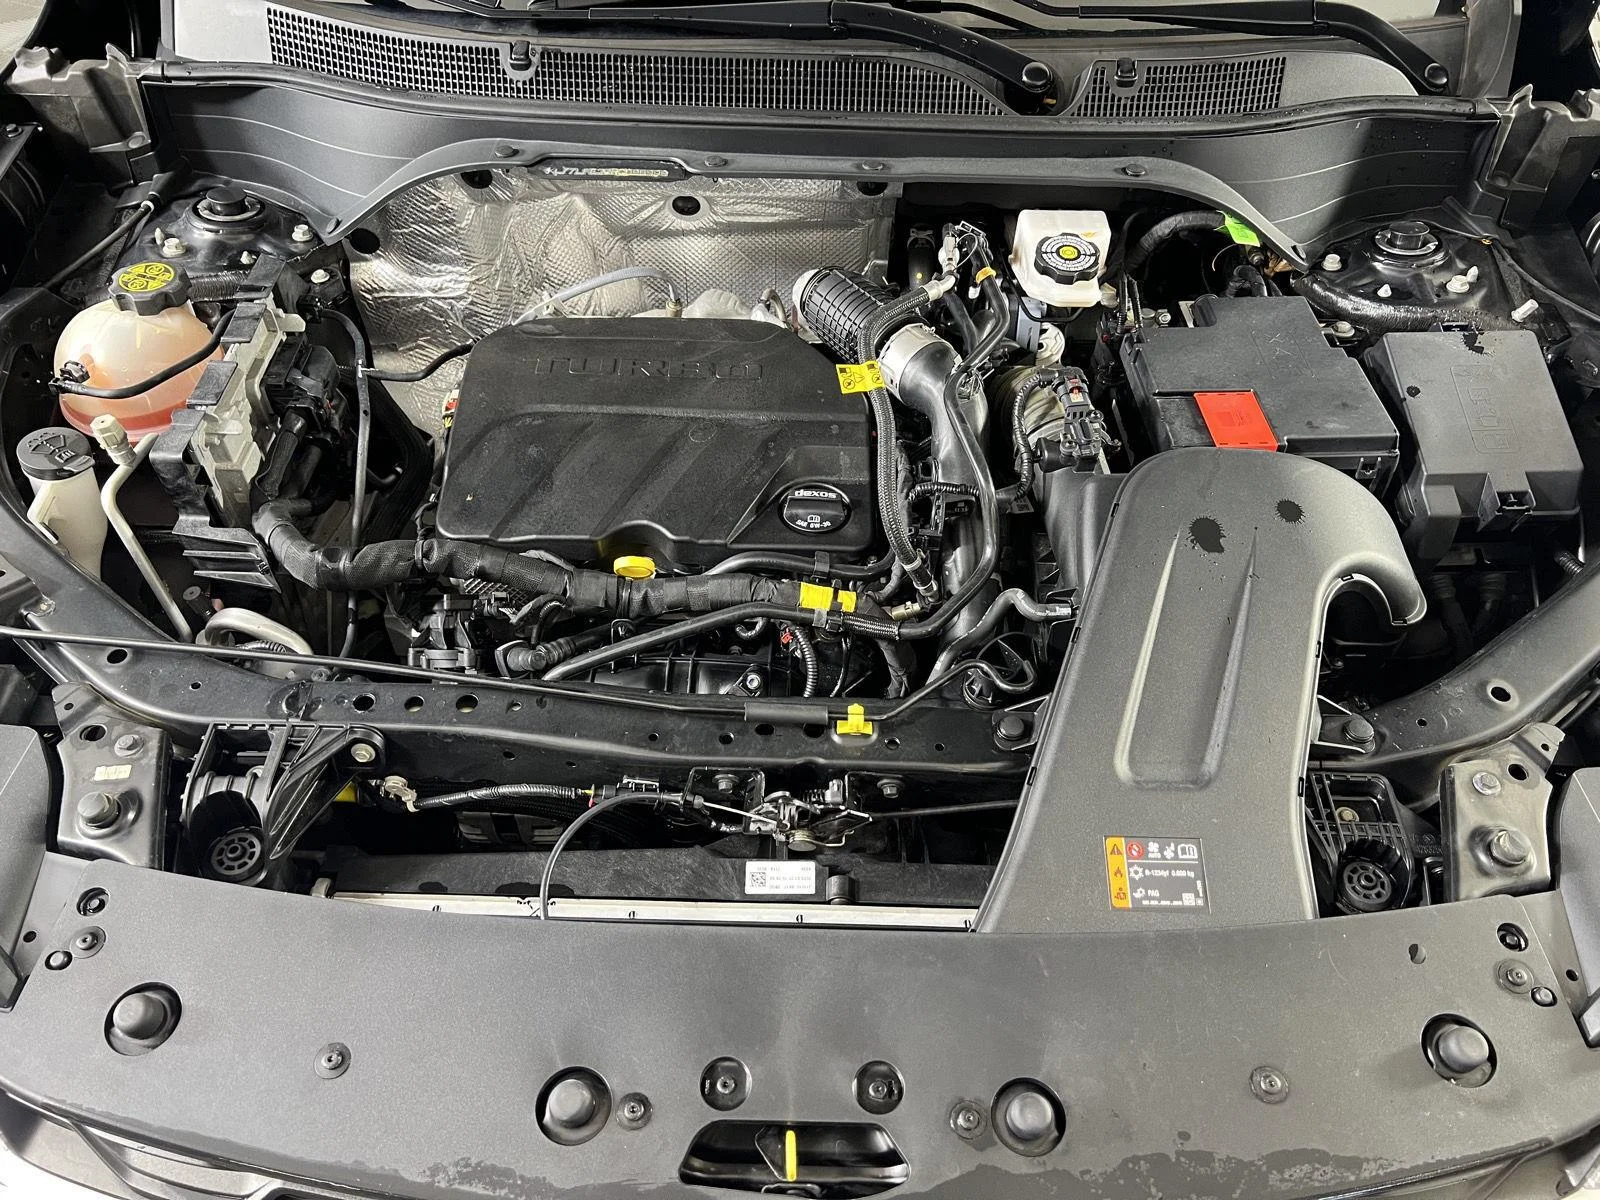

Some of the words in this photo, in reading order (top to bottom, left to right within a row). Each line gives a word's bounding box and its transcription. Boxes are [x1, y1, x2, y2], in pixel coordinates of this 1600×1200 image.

[523, 357, 763, 380] TURBO
[795, 489, 838, 499] dexos
[1147, 889, 1160, 897] PAG
